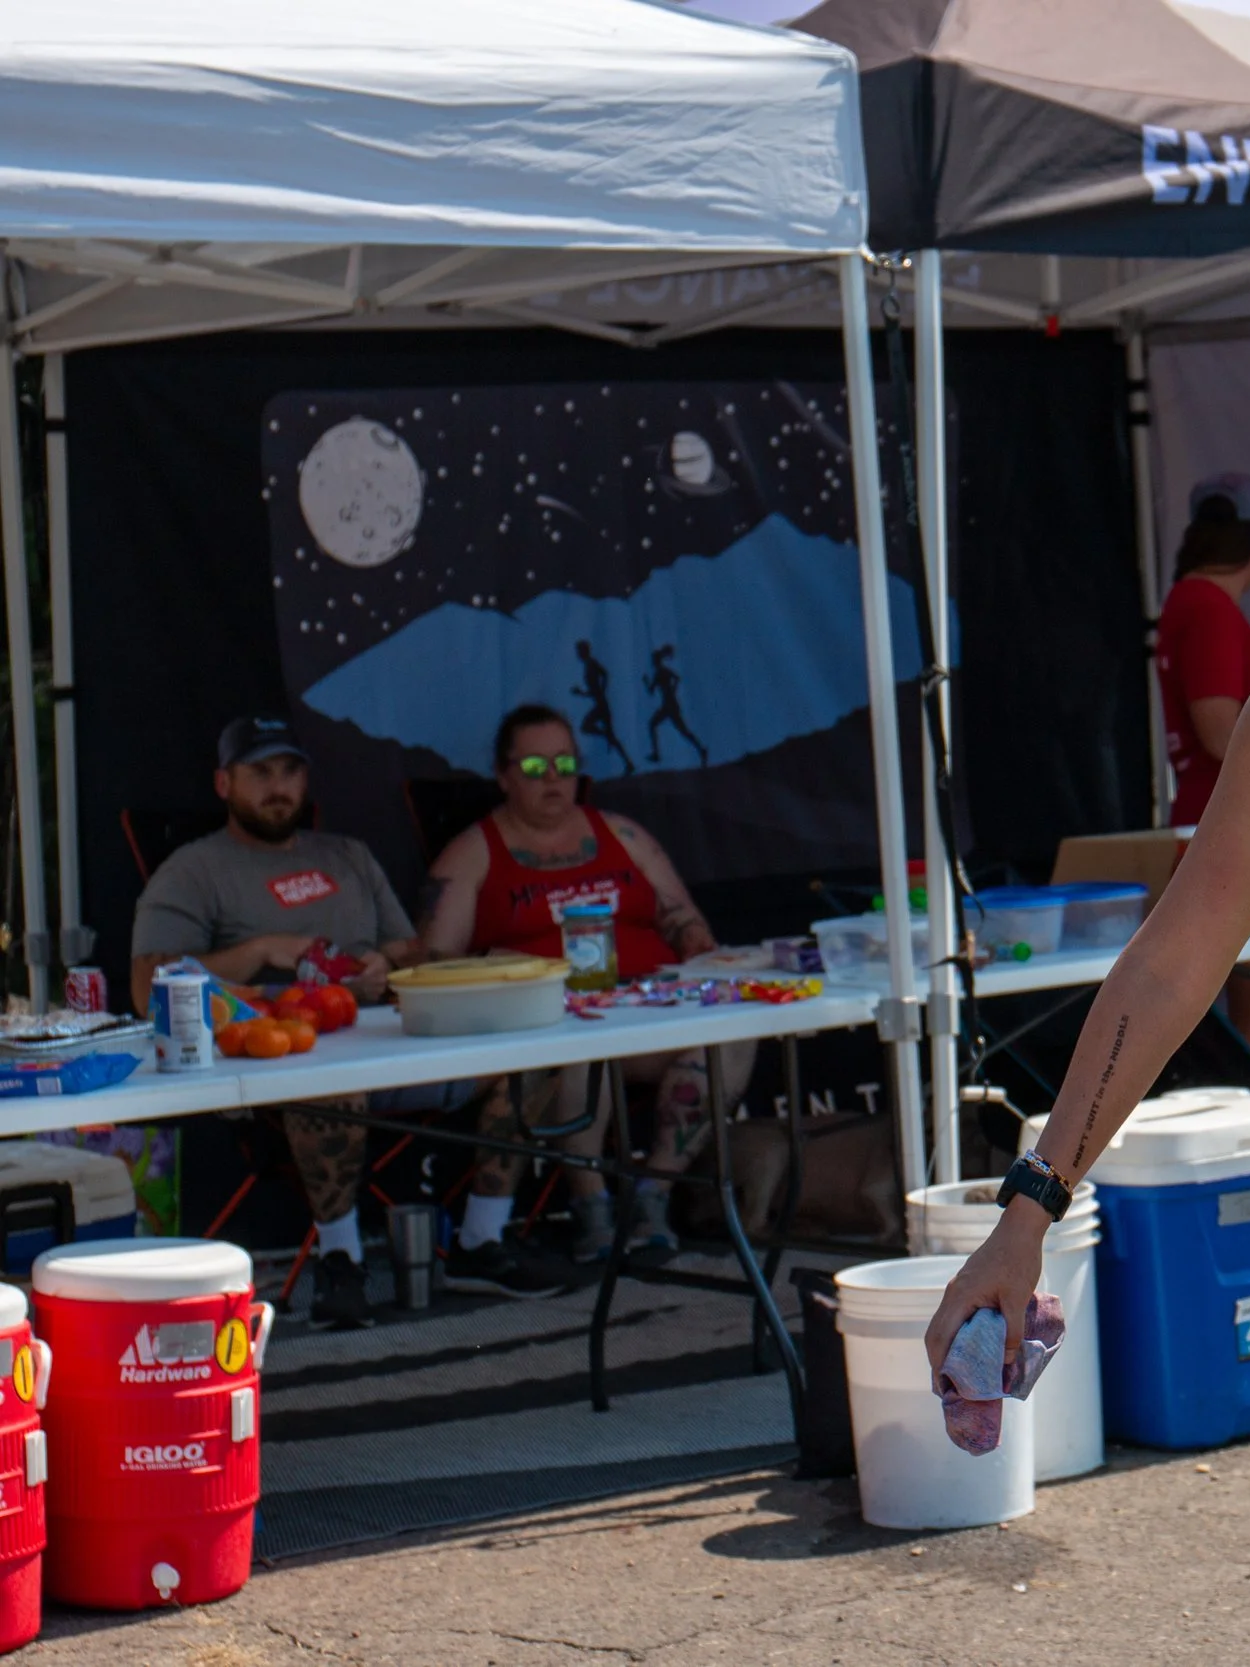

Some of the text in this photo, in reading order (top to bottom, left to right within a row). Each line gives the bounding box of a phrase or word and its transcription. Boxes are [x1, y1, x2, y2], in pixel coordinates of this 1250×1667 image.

[1111, 1014, 1129, 1062] MIDDLE
[119, 1364, 212, 1383] Hardware
[124, 1442, 204, 1464] IGLOO
